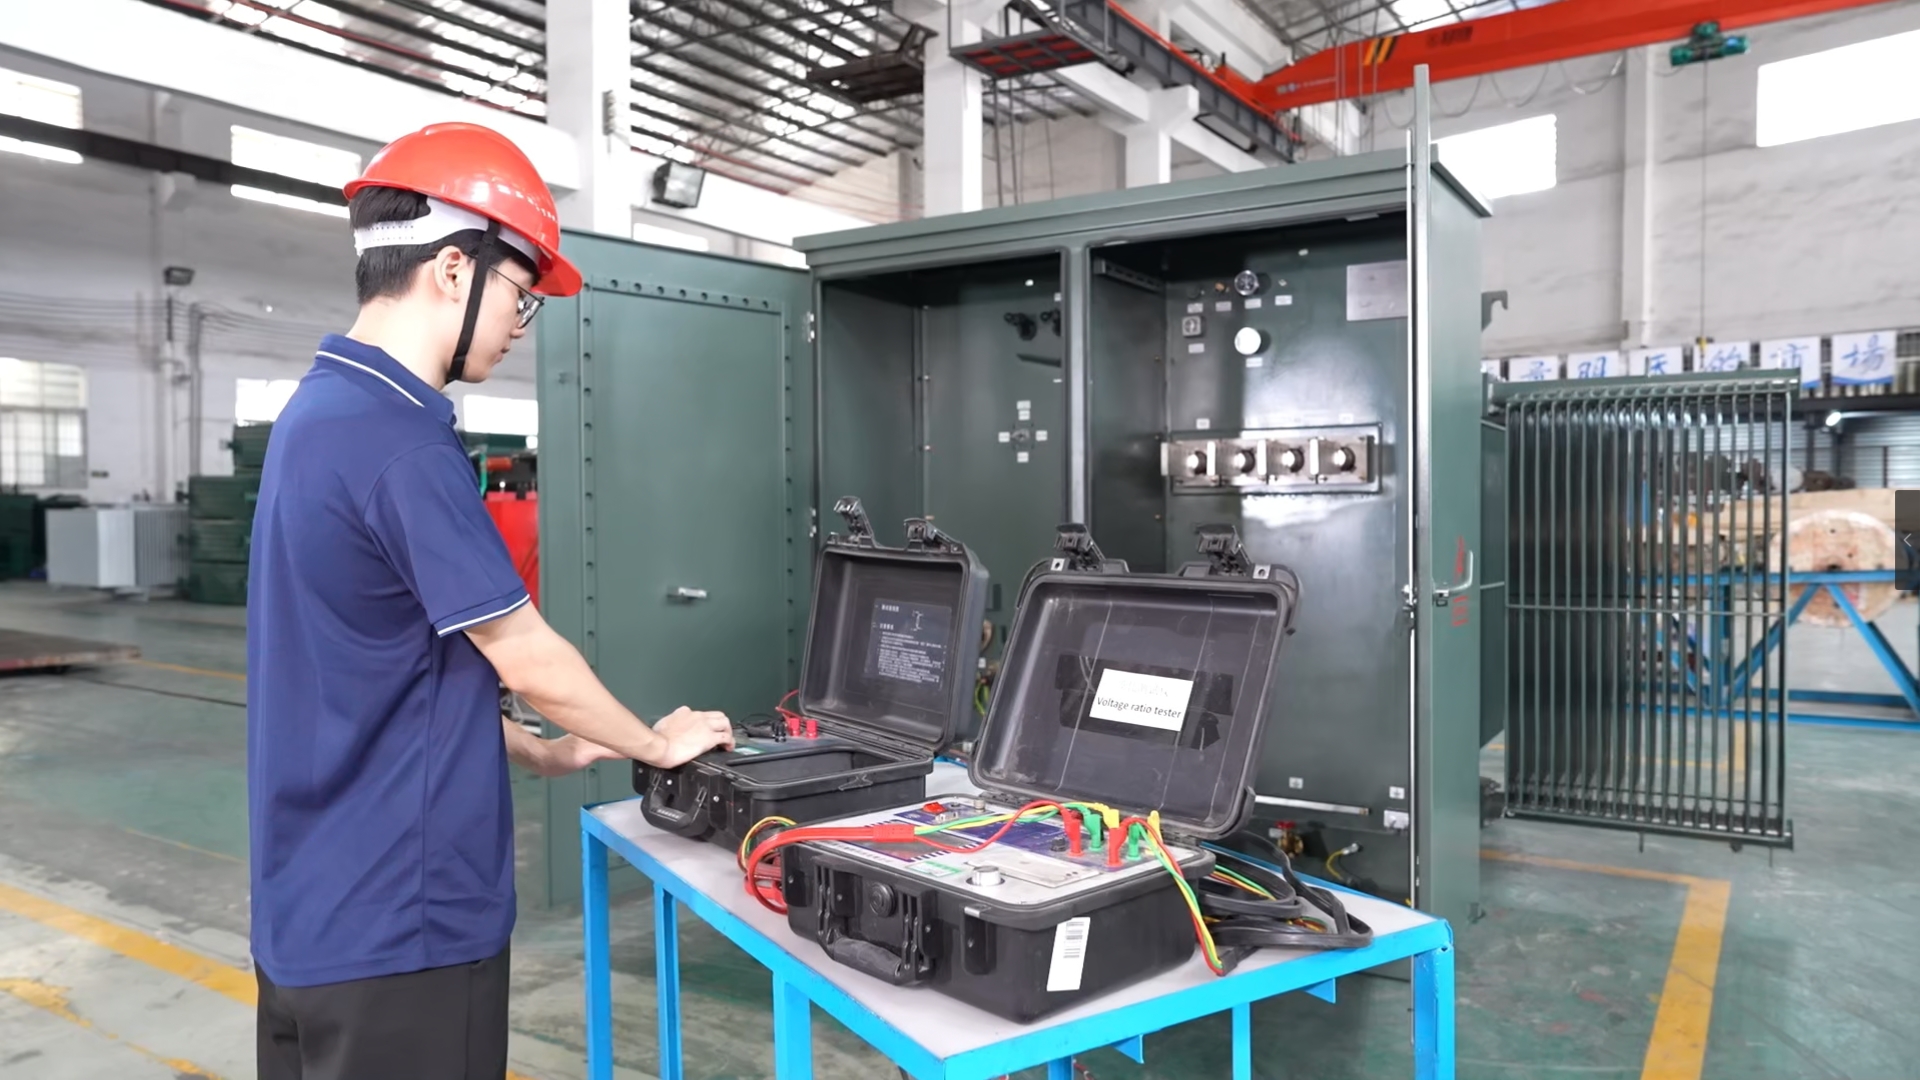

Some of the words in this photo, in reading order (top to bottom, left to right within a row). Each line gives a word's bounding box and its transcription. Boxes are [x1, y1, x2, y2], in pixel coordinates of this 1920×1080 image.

[1097, 697, 1129, 711] Voltage
[1131, 703, 1152, 714] ratio
[1154, 706, 1182, 719] tester
